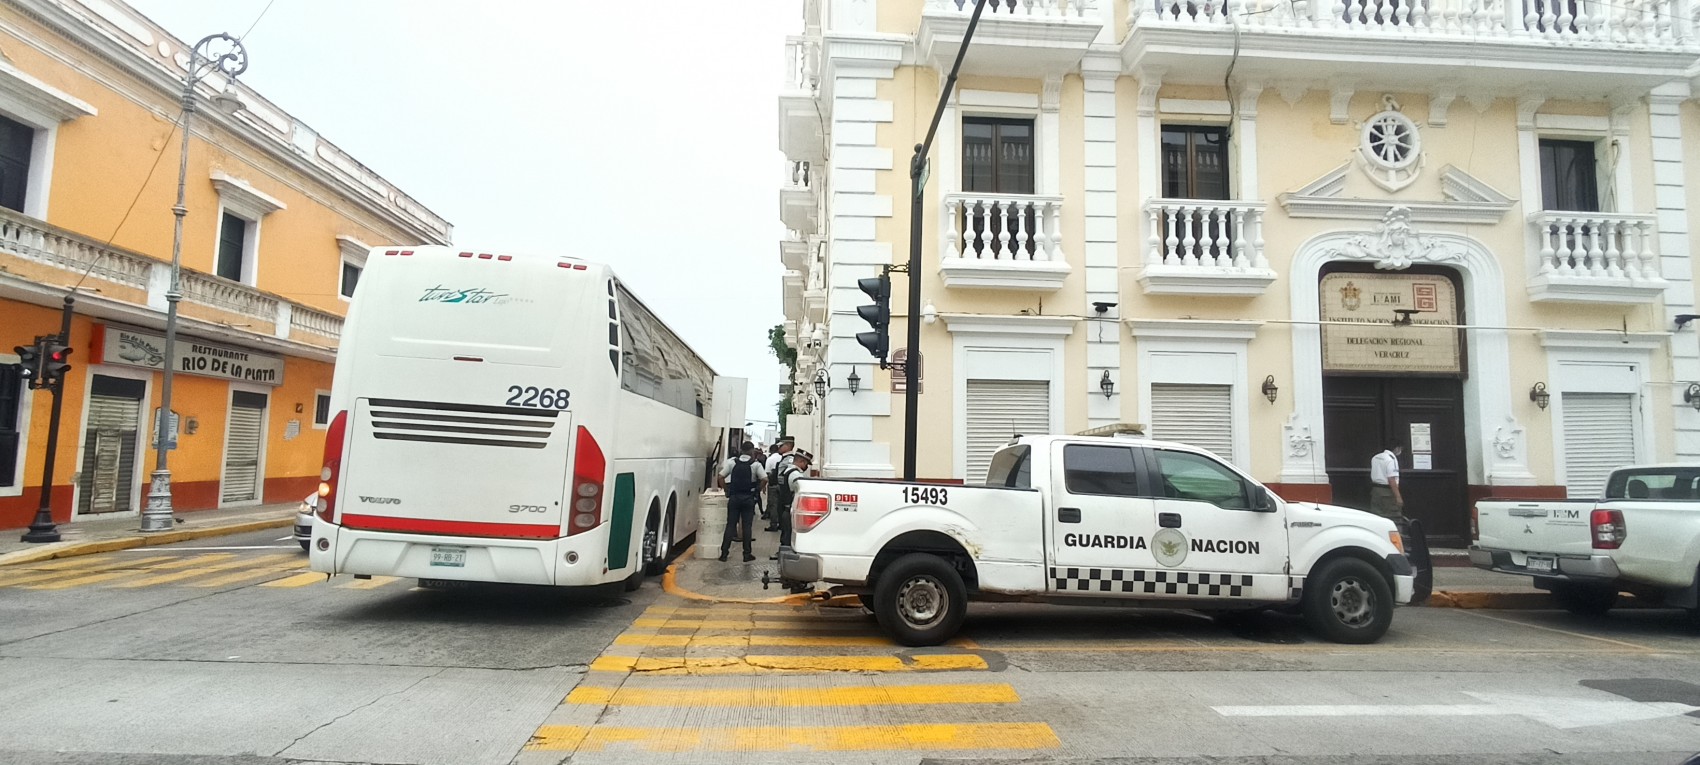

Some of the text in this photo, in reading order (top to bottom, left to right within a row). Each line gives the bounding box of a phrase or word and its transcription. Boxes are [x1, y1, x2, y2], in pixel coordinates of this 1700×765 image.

[191, 344, 249, 362] RESTAURANTE
[1374, 350, 1410, 359] VERACRUZ
[182, 356, 275, 382] RIO DE LA PLATA
[505, 384, 571, 410] 2268
[359, 495, 402, 505] VOLVO
[836, 494, 858, 502] 911
[902, 486, 948, 506] 15493
[508, 504, 547, 513] 9700
[1064, 532, 1260, 555] GUARDIA NACION
